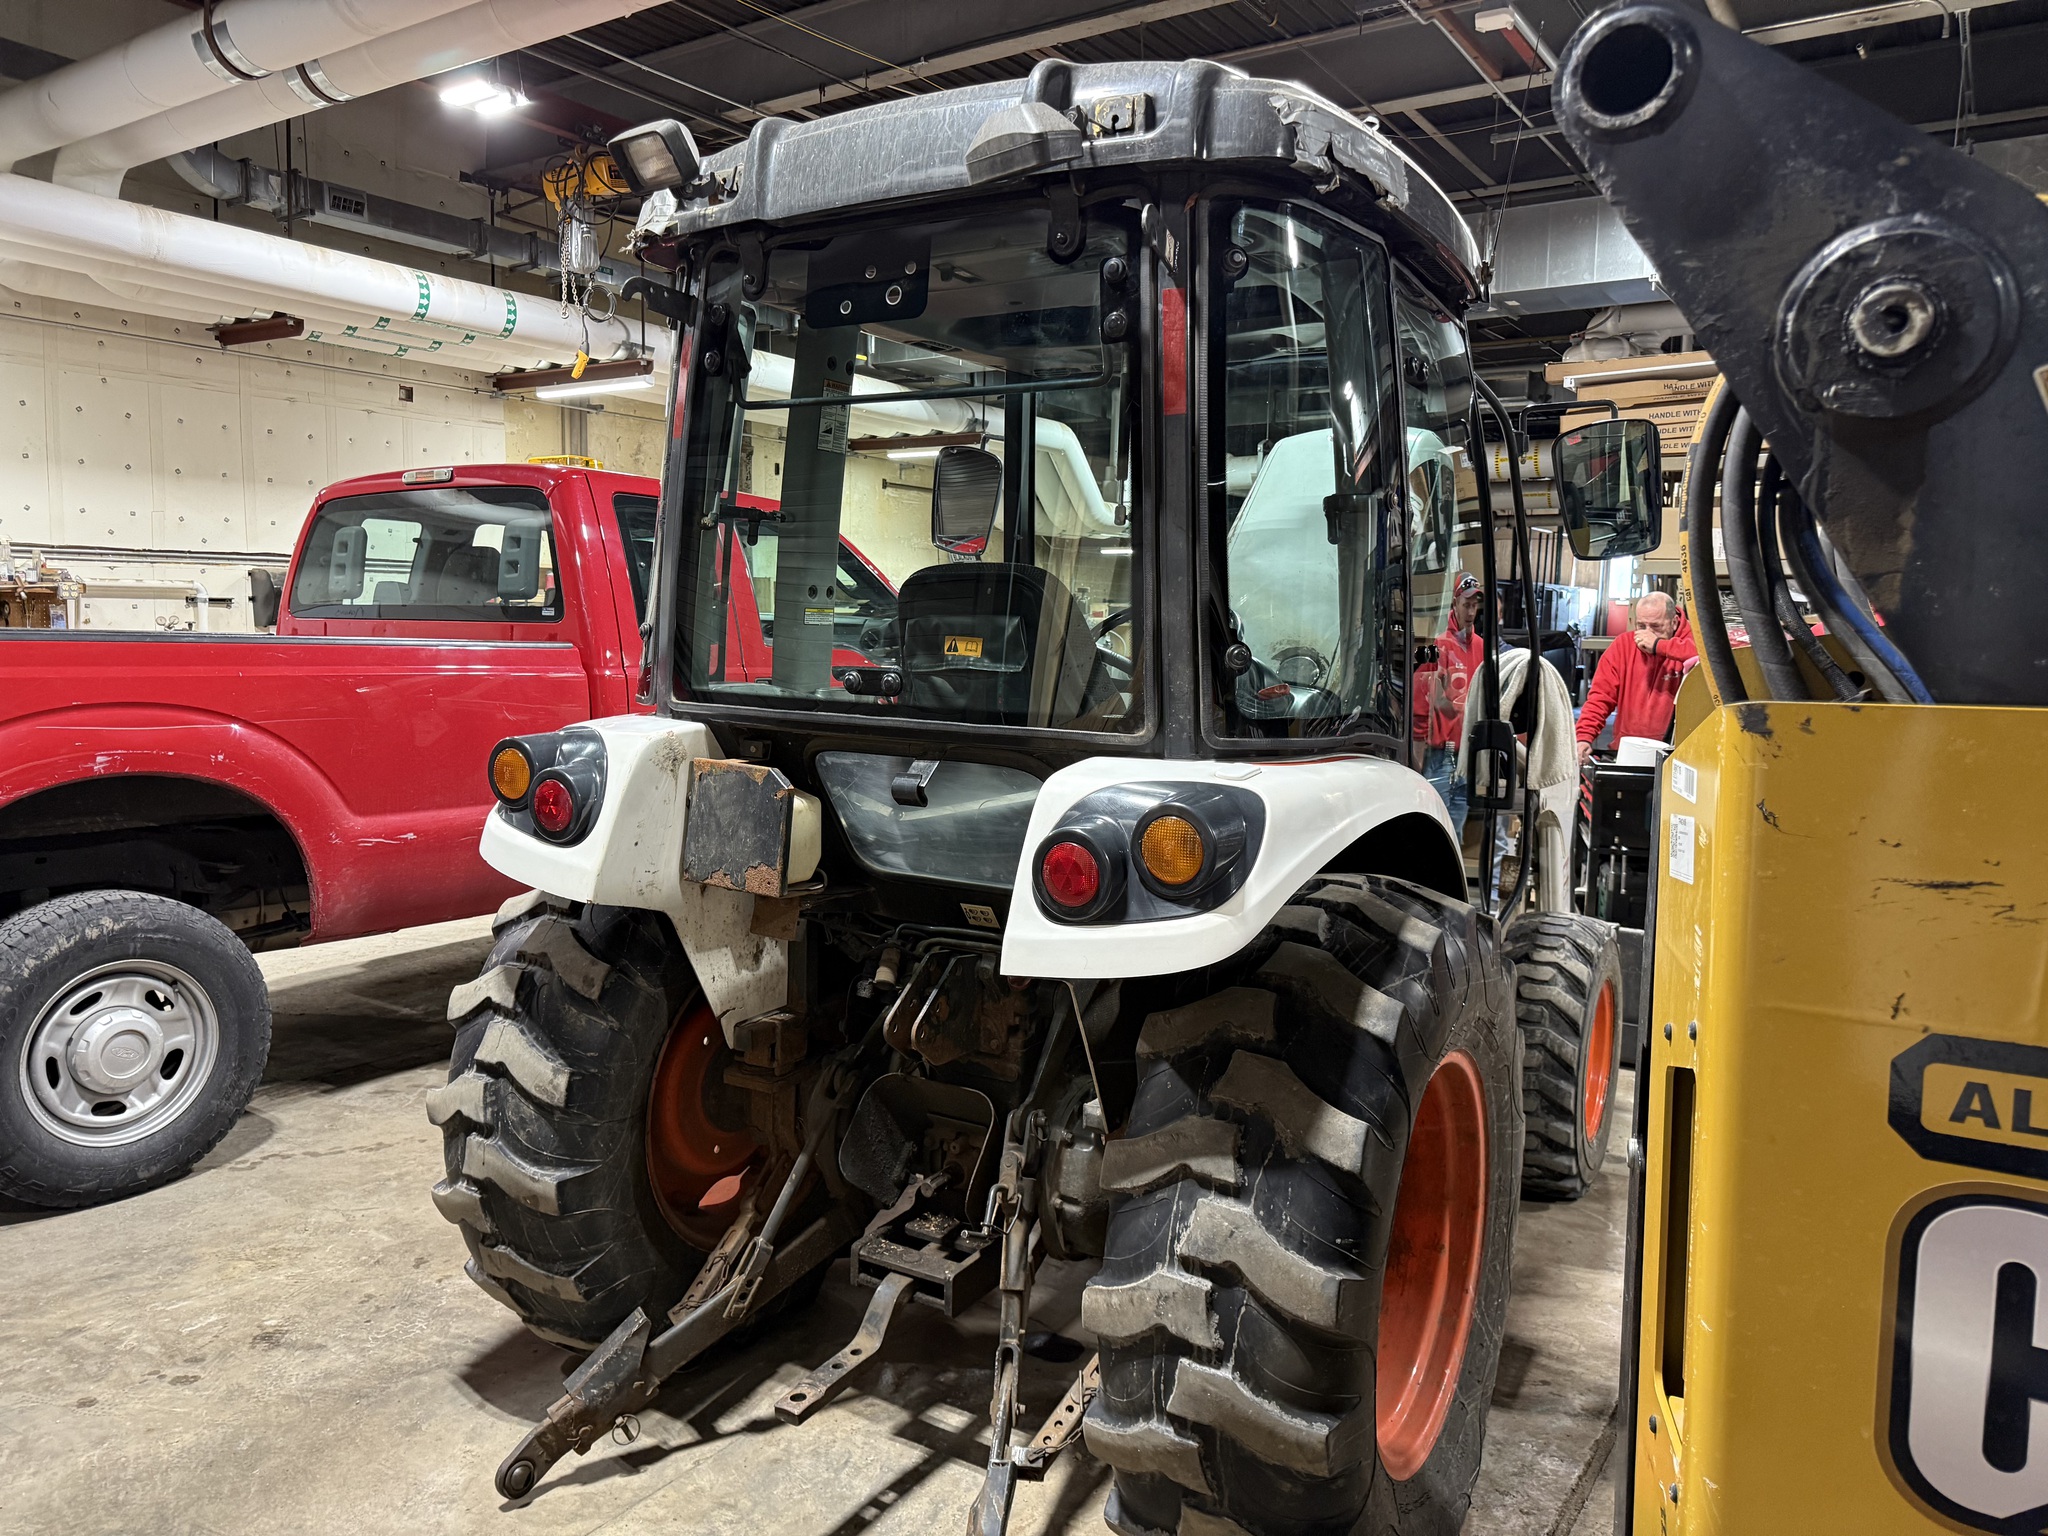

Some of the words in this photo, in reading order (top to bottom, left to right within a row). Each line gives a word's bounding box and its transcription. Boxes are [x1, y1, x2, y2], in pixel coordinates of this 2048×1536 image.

[1663, 383, 1695, 391] HANDLE
[1648, 411, 1681, 419] HANDLE
[1680, 544, 1688, 573] 4636
